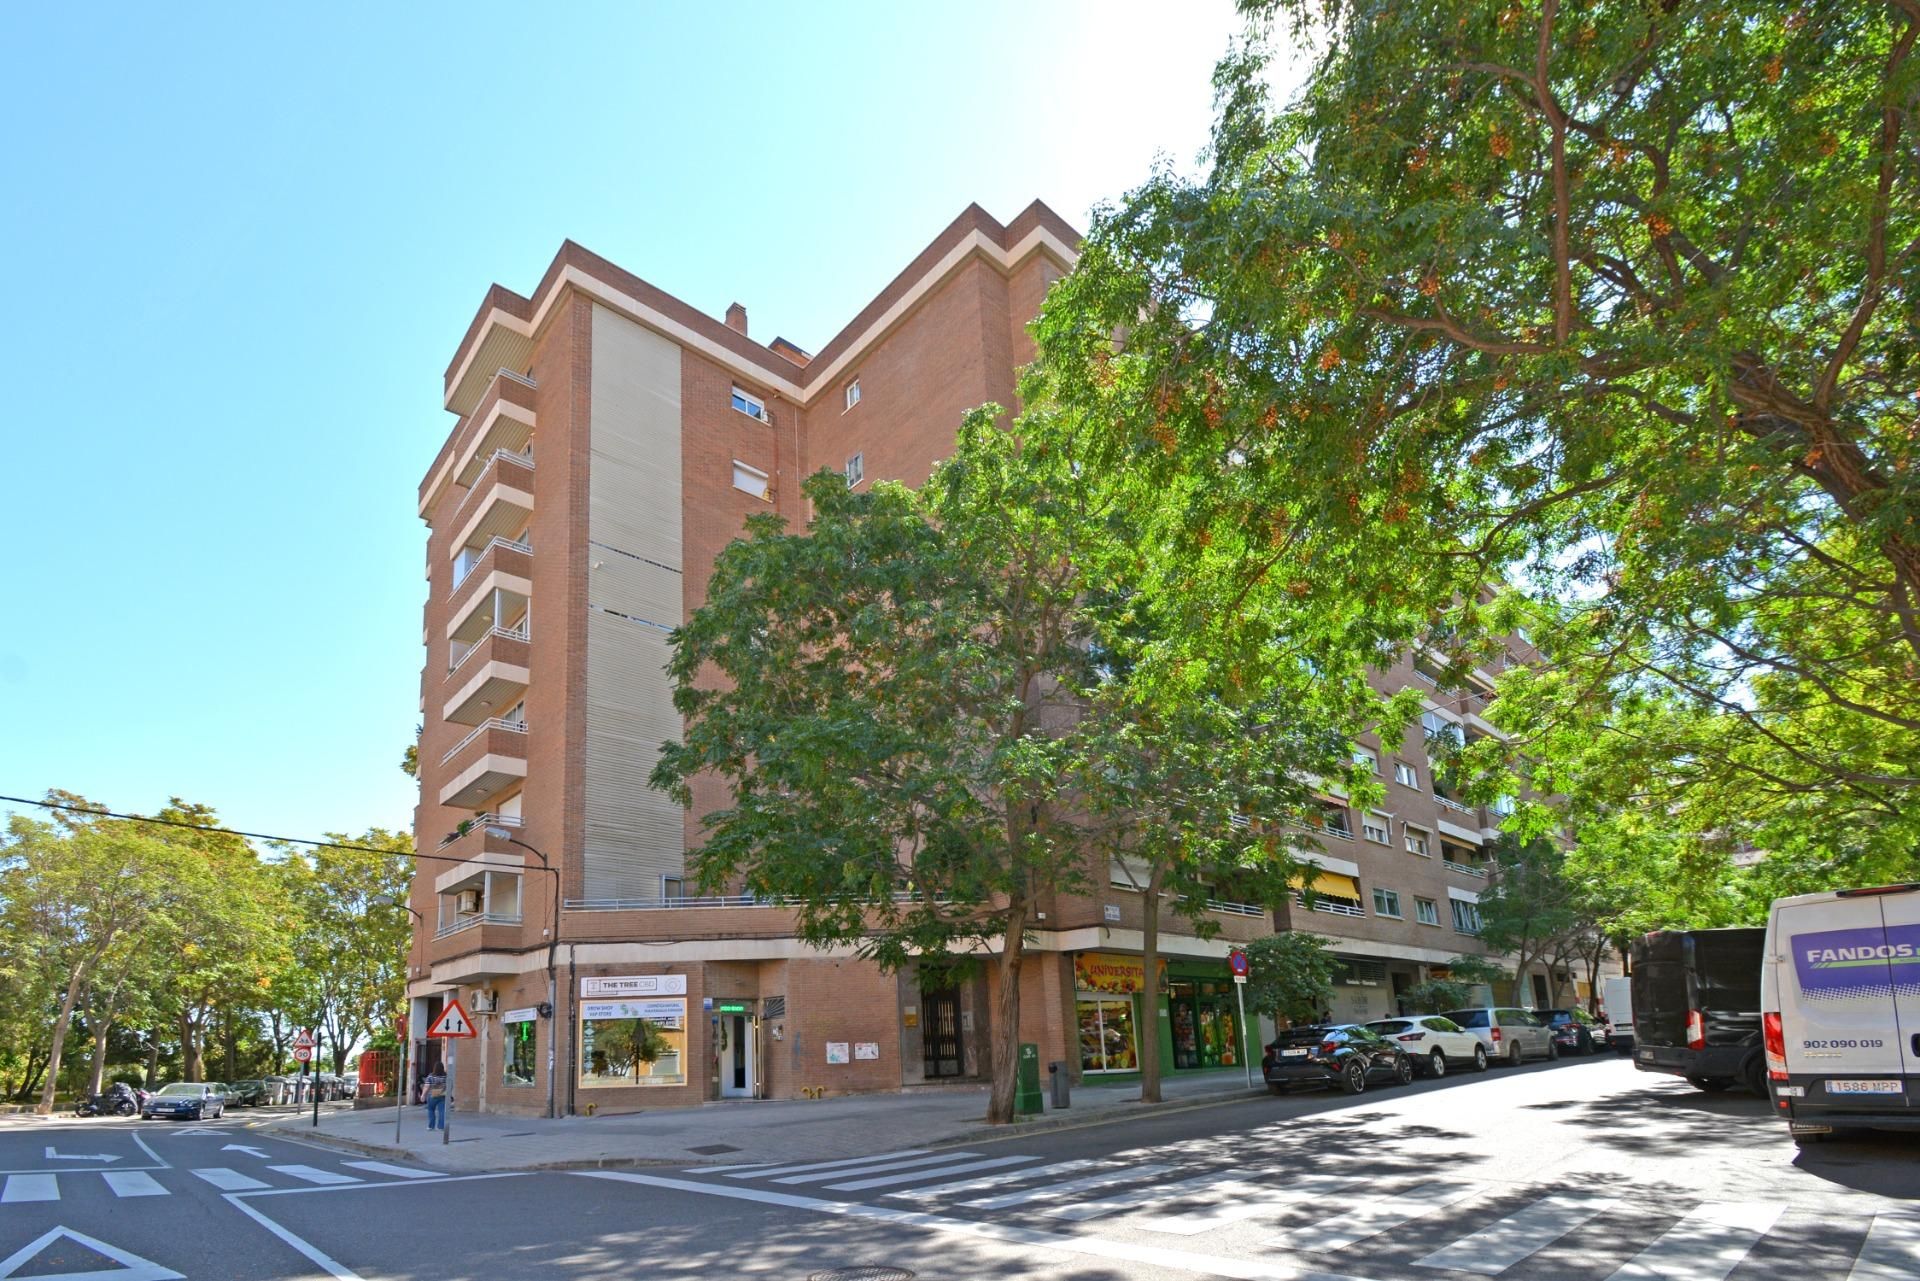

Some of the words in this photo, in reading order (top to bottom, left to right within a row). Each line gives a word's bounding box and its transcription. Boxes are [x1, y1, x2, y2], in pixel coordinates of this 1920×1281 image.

[1807, 944, 1912, 962] FANDOS
[1091, 964, 1144, 977] UNIVERSITA
[1803, 1040, 1828, 1048] 902
[1830, 1040, 1857, 1048] 090
[1860, 1040, 1883, 1048] 019
